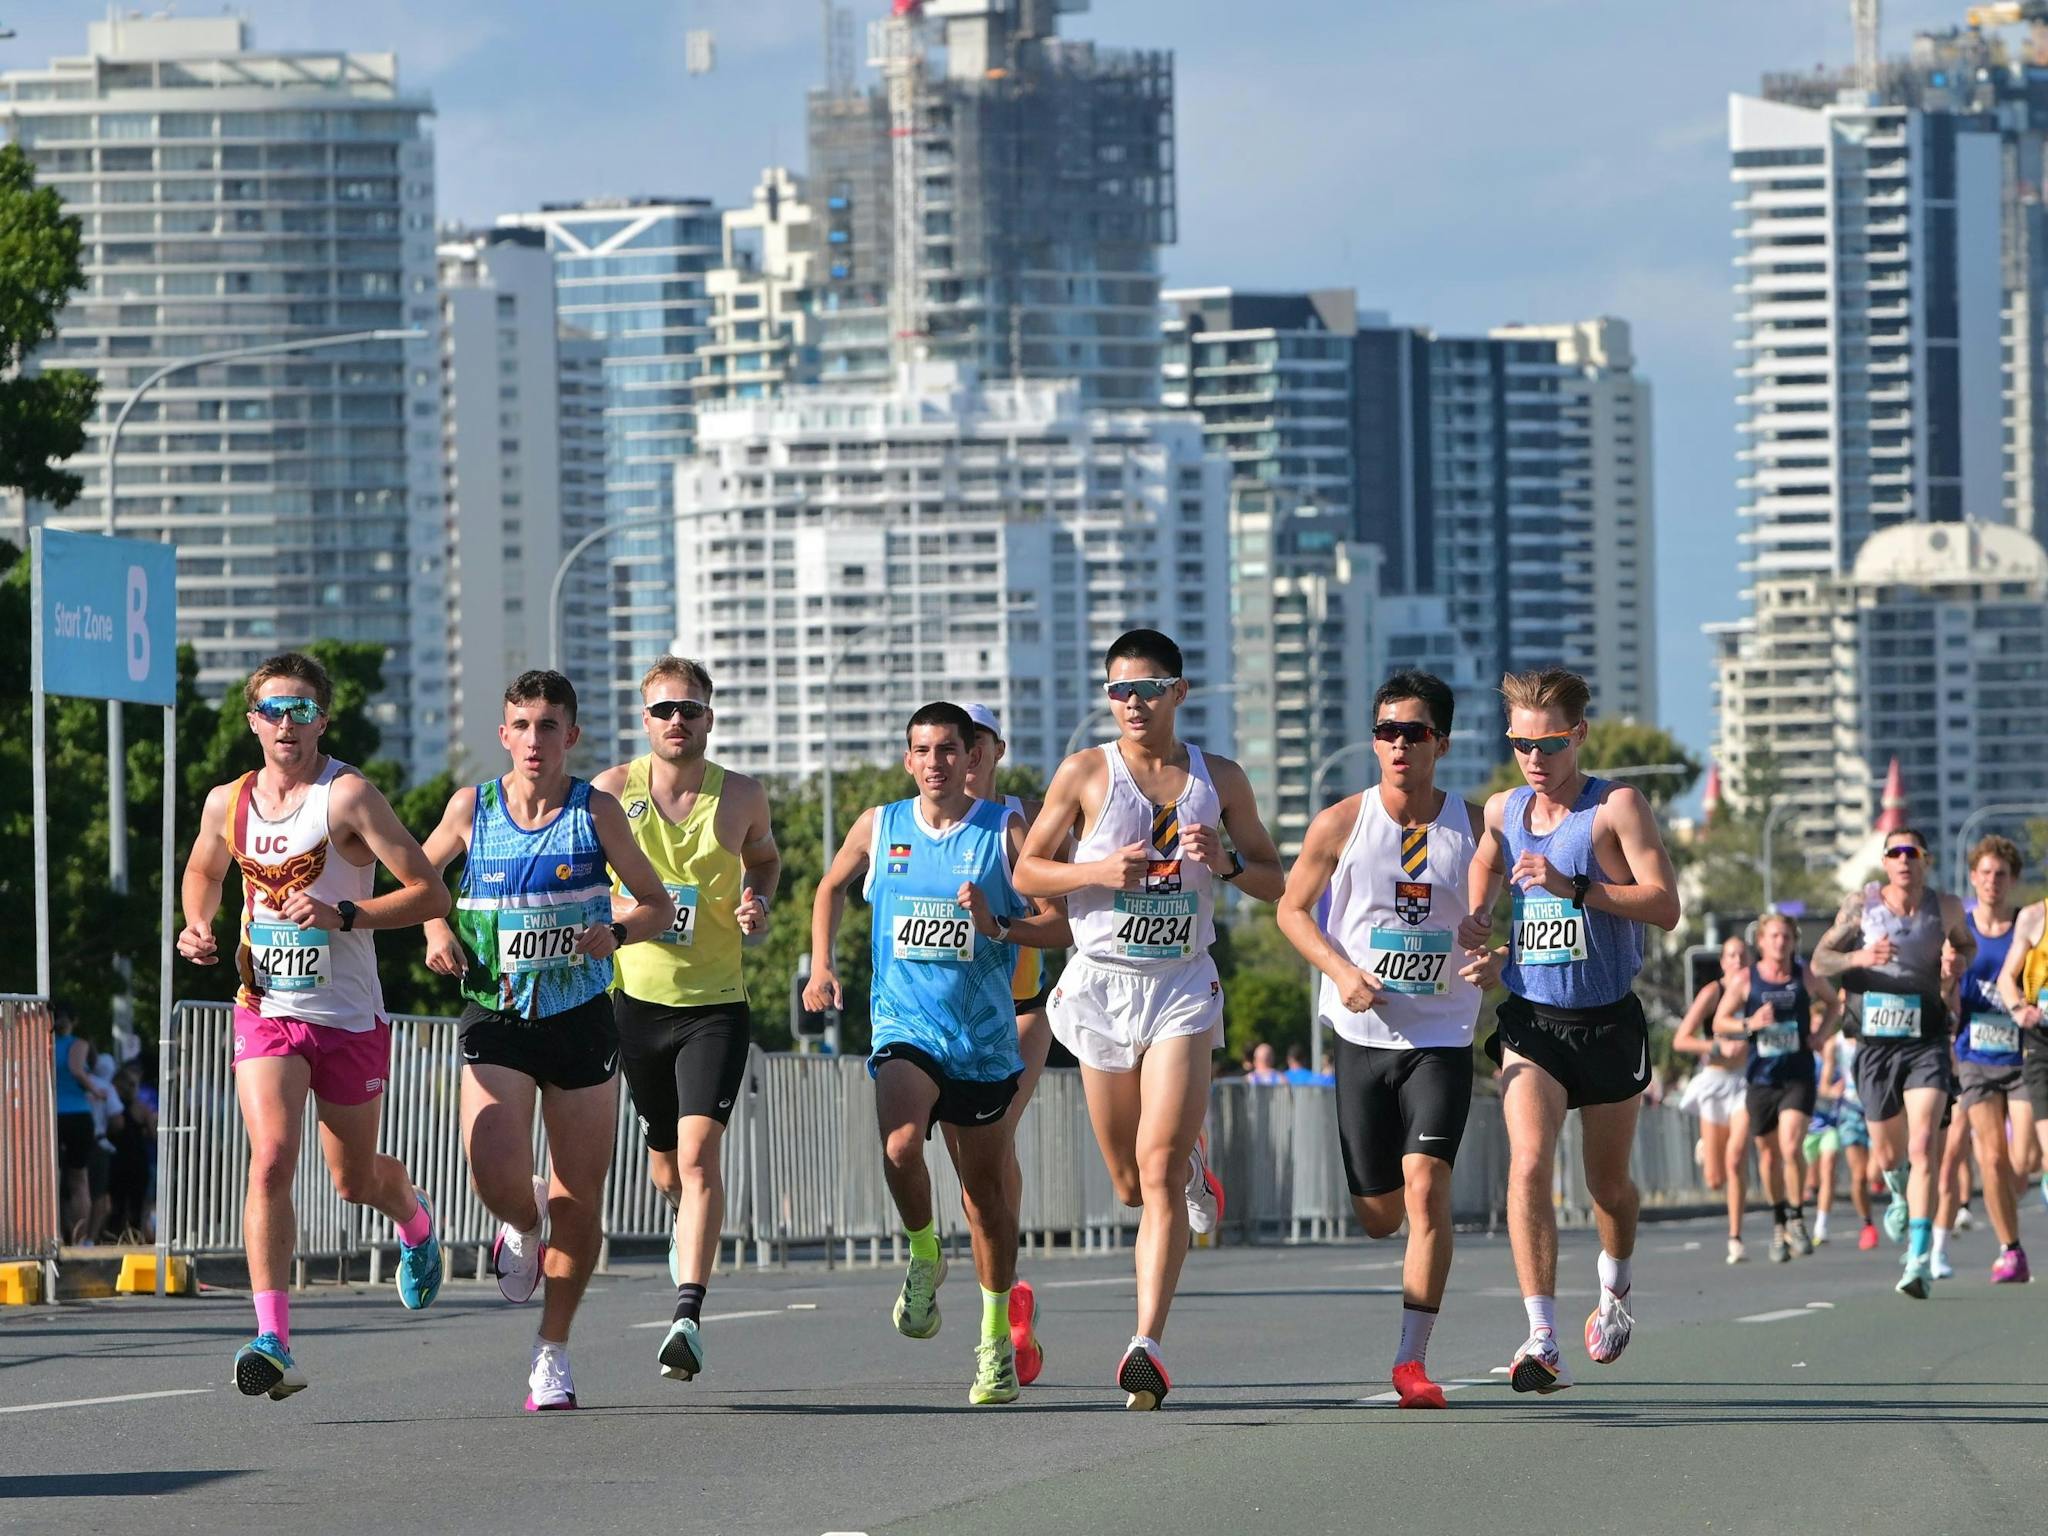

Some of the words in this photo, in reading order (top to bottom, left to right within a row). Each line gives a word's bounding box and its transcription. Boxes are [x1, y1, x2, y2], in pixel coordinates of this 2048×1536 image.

[54, 602, 81, 638] Start
[84, 605, 113, 642] Zone
[127, 565, 150, 682] B
[255, 836, 288, 854] UC
[912, 901, 955, 918] XAVIER
[1124, 898, 1190, 915] THEEJUTHA
[1523, 903, 1563, 919] MATHER
[523, 912, 557, 929] EWAN
[1117, 916, 1192, 945] 40234
[272, 931, 300, 946] KYLE
[507, 927, 574, 959] 40178
[897, 918, 969, 948] 40226
[1403, 936, 1422, 951] YIU
[1518, 919, 1577, 950] 40220
[259, 947, 320, 976] 42112
[1373, 952, 1447, 982] 40237
[1871, 1008, 1915, 1026] 40174
